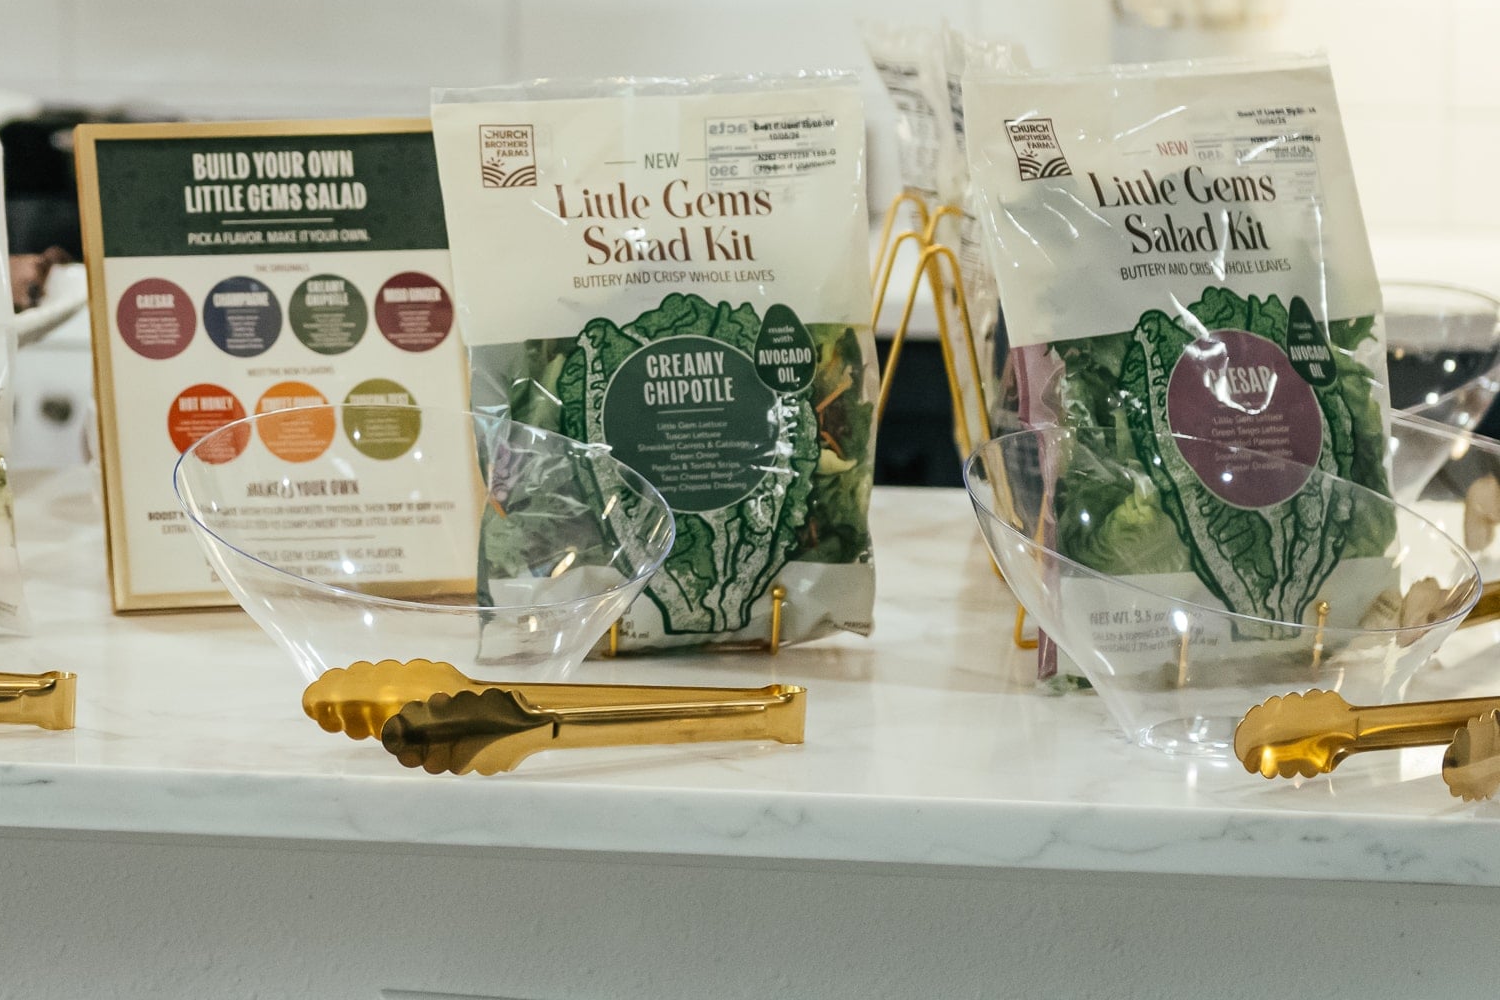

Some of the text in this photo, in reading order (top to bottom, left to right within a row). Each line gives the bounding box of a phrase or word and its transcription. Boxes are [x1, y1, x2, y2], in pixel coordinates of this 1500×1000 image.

[484, 129, 528, 139] CHURCH
[1011, 124, 1049, 134] CHURCH
[484, 140, 528, 149] BROTHERS
[1014, 134, 1052, 142] BROTHERS
[1027, 141, 1055, 150] FARMS
[496, 149, 529, 157] FARMS
[1157, 140, 1189, 157] NEW
[192, 150, 354, 180] BUILD YOUR OWN
[644, 153, 680, 169] NEW
[1088, 165, 1277, 209] Little Gems
[185, 182, 367, 213] LITTLE GEMS SALAD
[554, 178, 773, 220] Little Gems
[188, 229, 371, 245] PICK A FLAVOR. MAKE IT YOUR OWN.
[1125, 211, 1271, 254] Salad Kit
[703, 225, 757, 262] Kit
[1121, 258, 1291, 281] BUTTERY AND LEAVES
[573, 269, 775, 289] BUTTERY AND CRISP WHOLE LEAVES
[768, 325, 795, 334] made
[773, 335, 794, 344] with
[759, 348, 812, 366] AVOCADO
[1290, 345, 1331, 362] AVOCADO
[646, 351, 725, 378] CREAMY
[1309, 363, 1326, 378] OIL
[778, 367, 796, 383] OIL
[644, 377, 735, 406] CHIPOTLE
